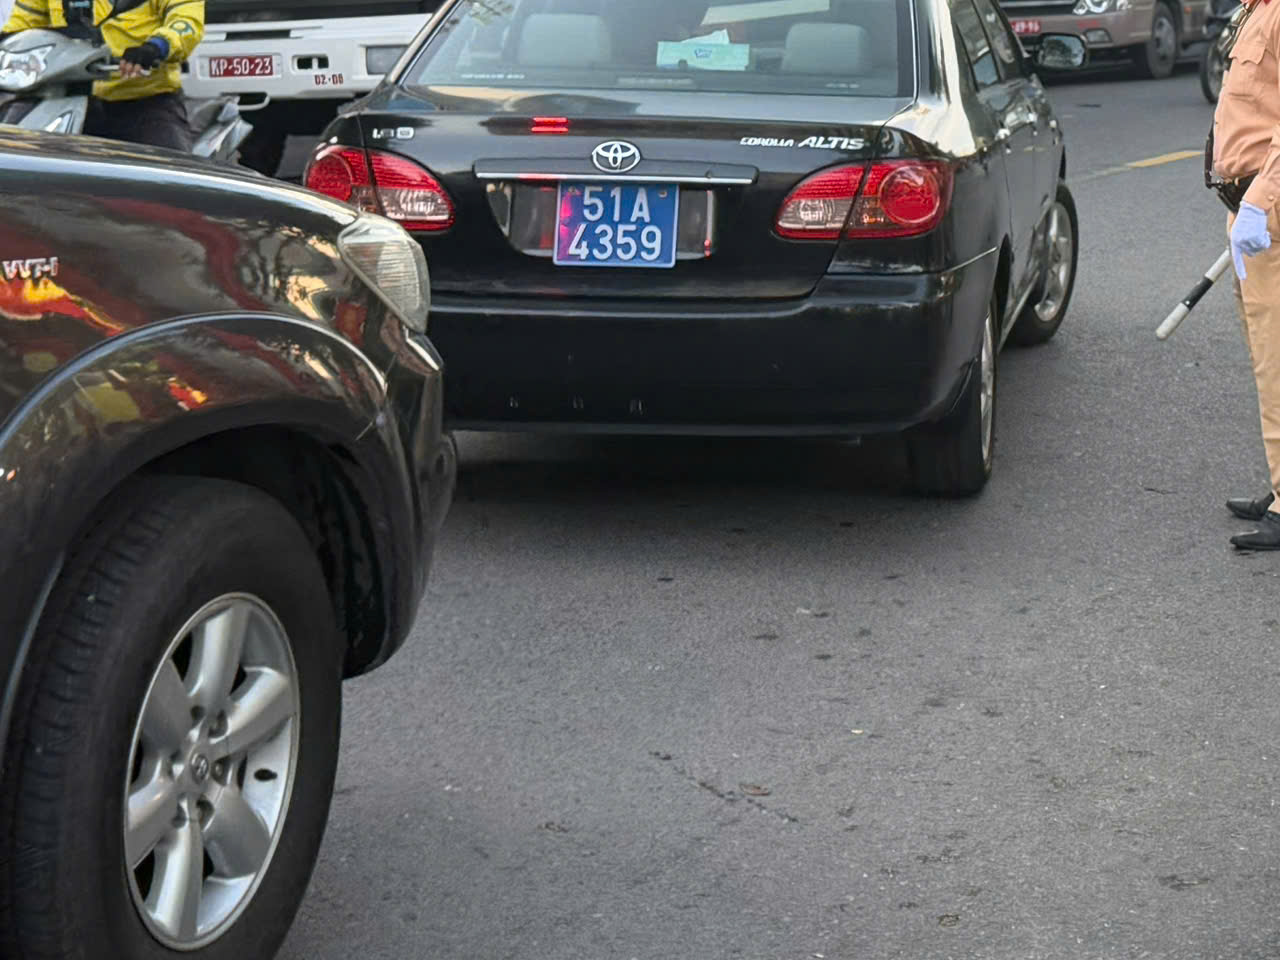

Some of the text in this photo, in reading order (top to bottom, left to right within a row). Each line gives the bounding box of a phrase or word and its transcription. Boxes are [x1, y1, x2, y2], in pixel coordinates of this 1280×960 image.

[211, 57, 271, 76] KP-50-23
[740, 136, 865, 149] COROLLA ALTIS
[583, 186, 651, 223] 51A
[568, 223, 662, 261] 4359
